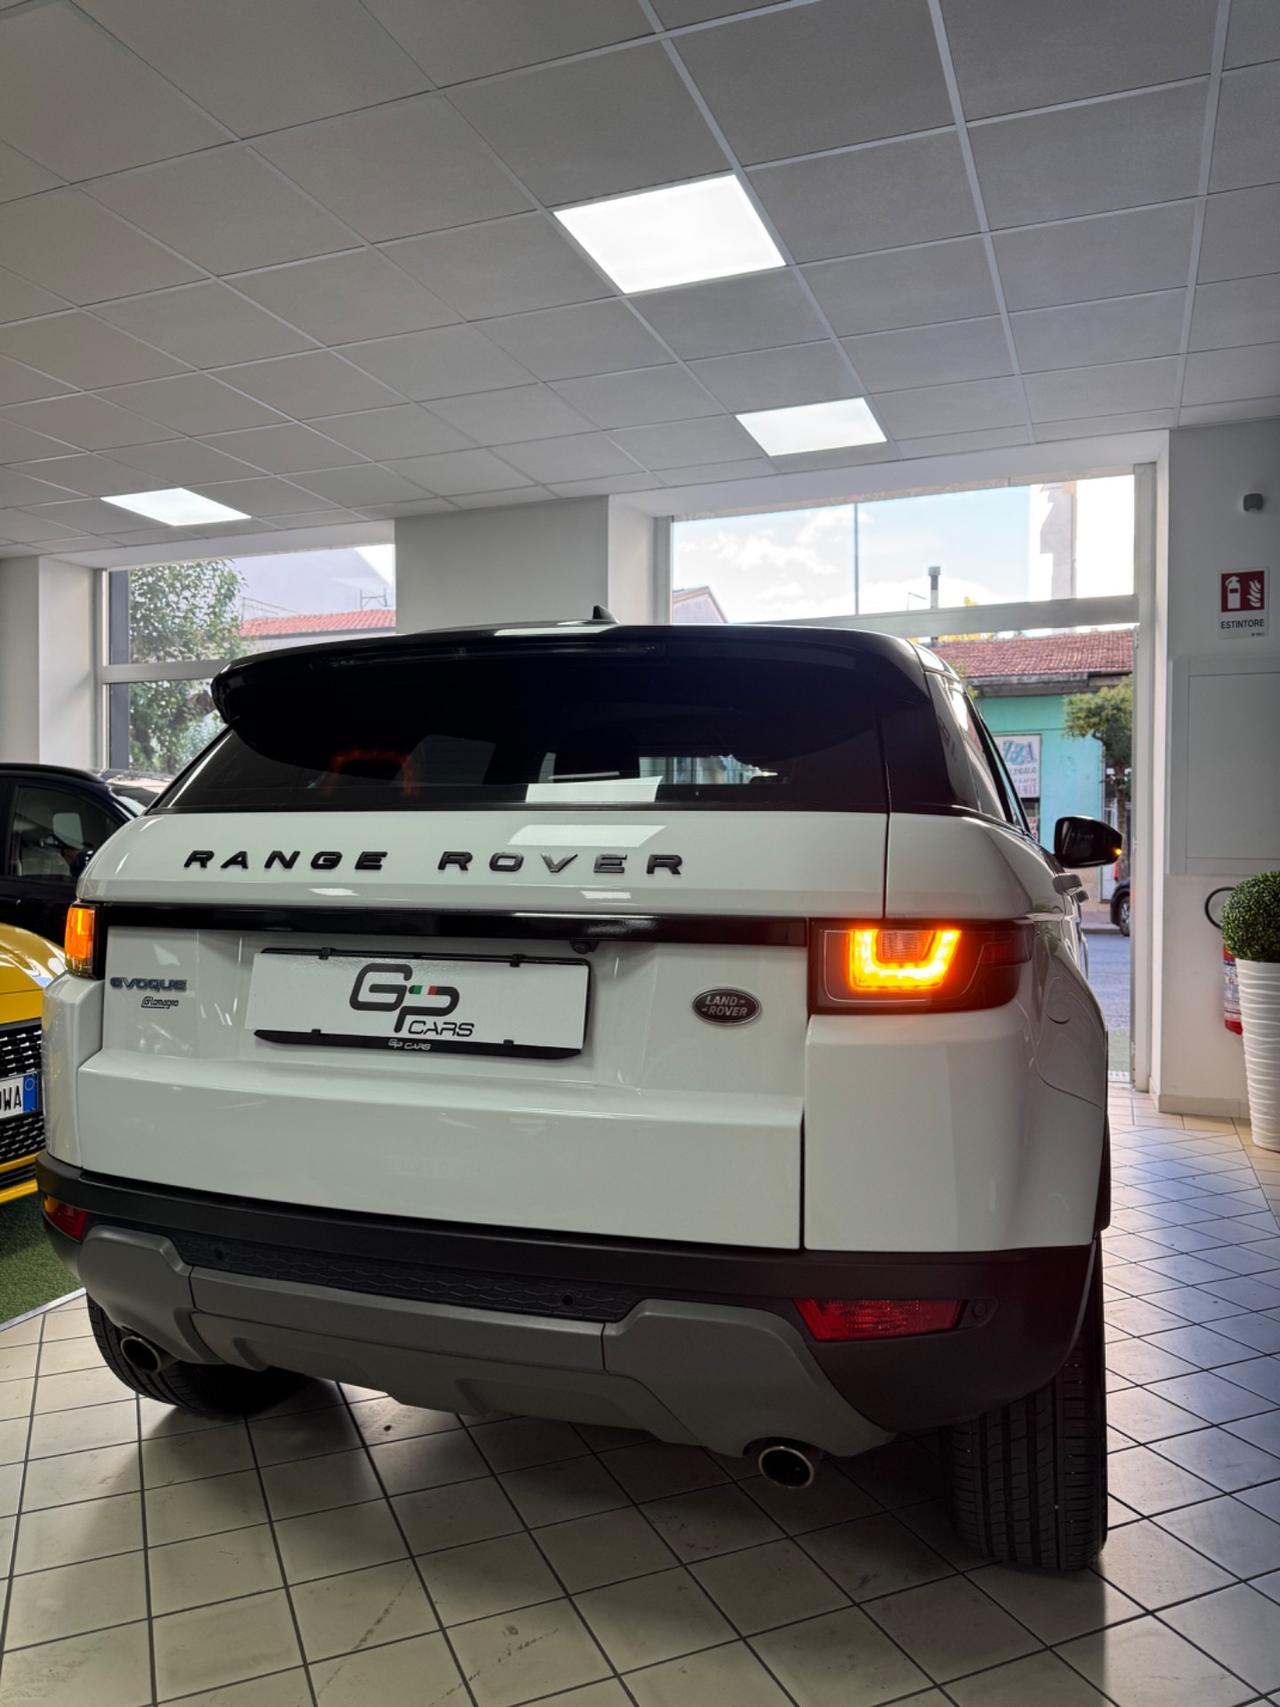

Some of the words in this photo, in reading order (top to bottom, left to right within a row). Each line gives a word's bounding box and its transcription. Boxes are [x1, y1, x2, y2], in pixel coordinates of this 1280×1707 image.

[1221, 619, 1265, 630] ESTINTORE
[184, 850, 388, 870] RANGE
[437, 851, 683, 874] ROVER
[110, 977, 187, 992] EVOQUE
[408, 1020, 474, 1037] CARS
[0, 1085, 22, 1112] WA
